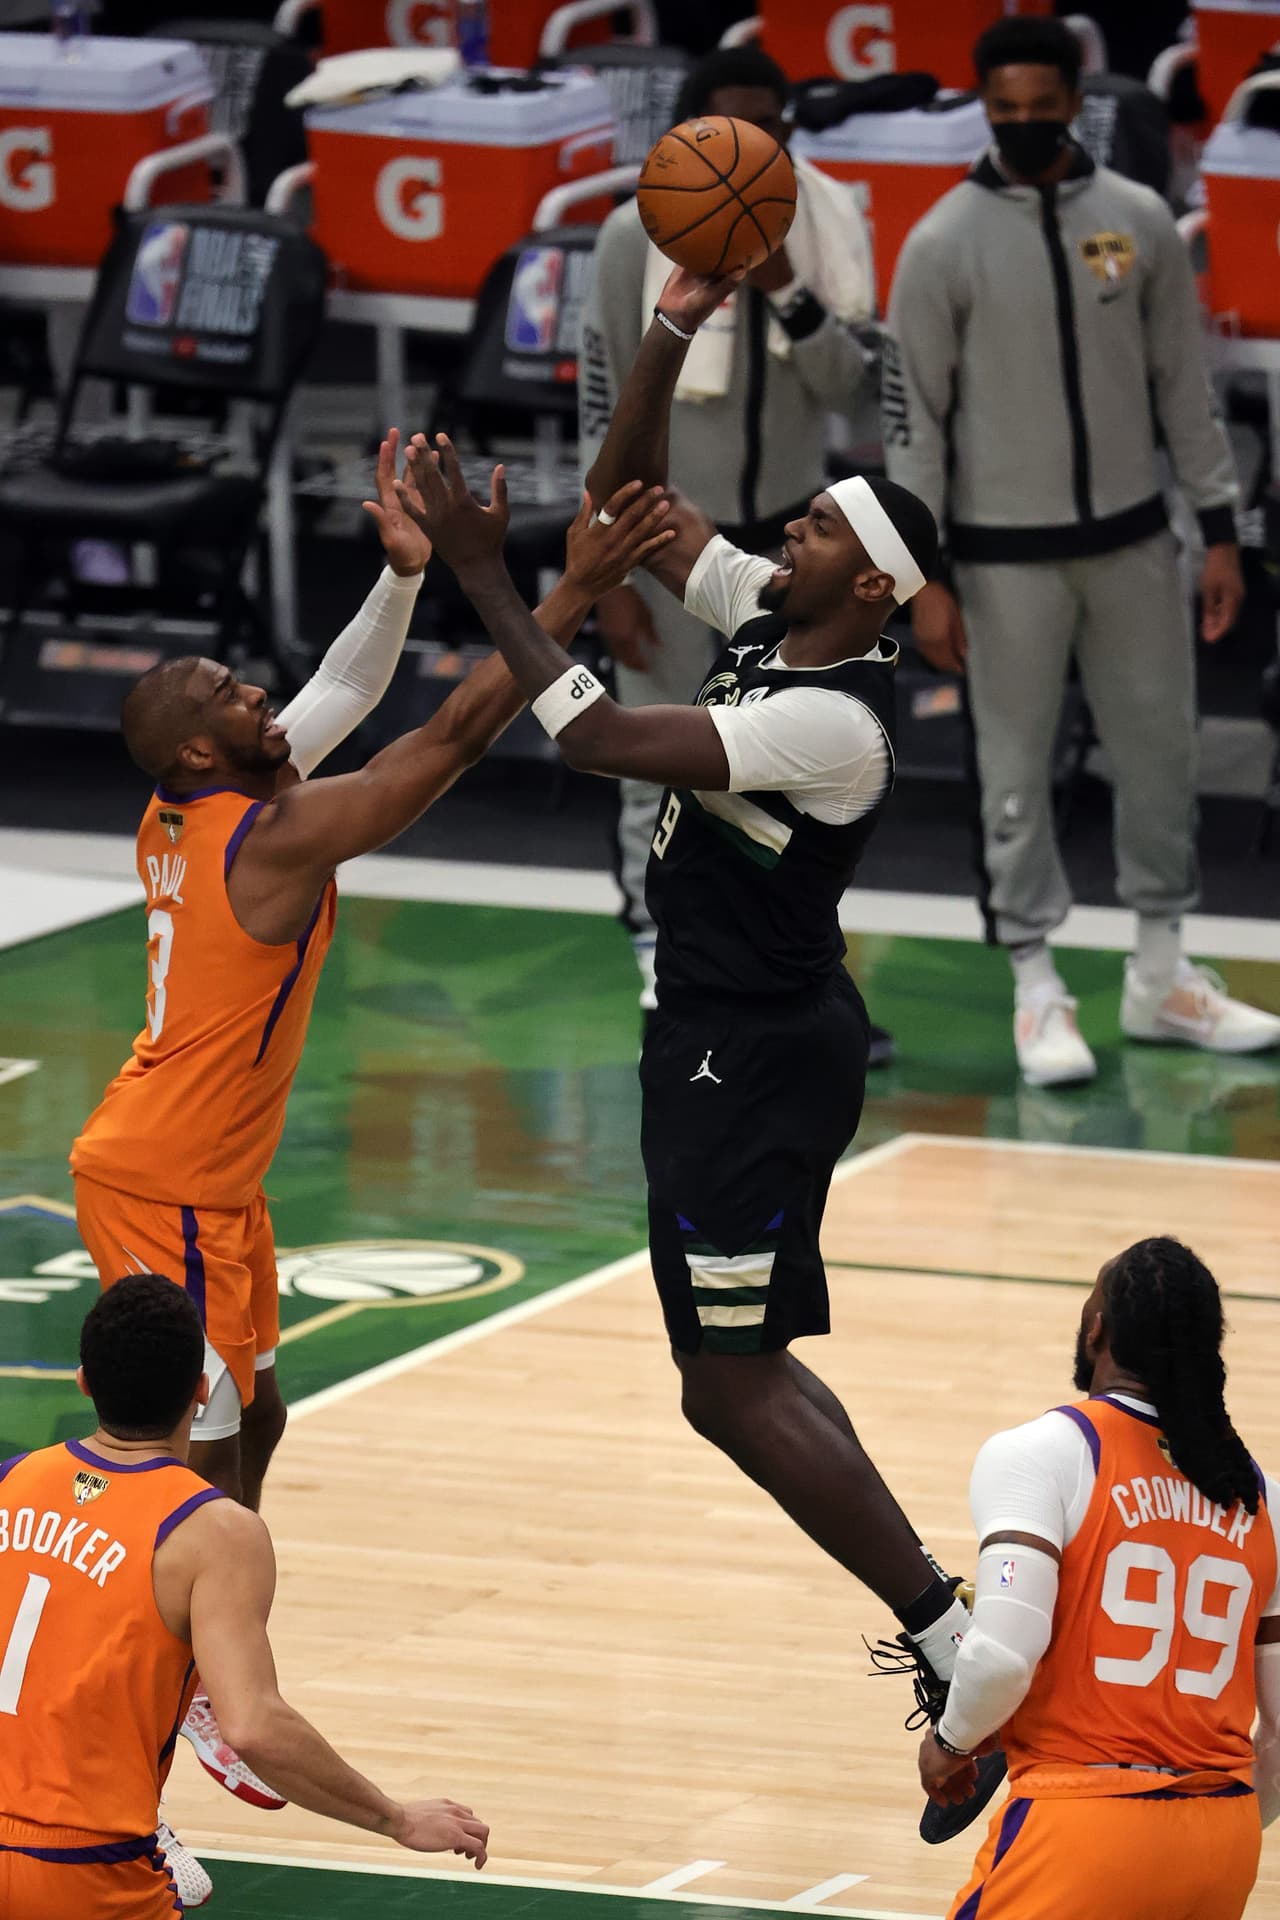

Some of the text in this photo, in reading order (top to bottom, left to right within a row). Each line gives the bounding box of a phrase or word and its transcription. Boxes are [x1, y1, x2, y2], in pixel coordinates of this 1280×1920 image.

[826, 4, 896, 82] G
[0, 127, 56, 212] G
[374, 155, 446, 242] G
[570, 673, 595, 700] BP
[652, 791, 682, 861] 9
[146, 853, 187, 905] PAUL
[1111, 1475, 1255, 1549] CROWDER
[0, 1571, 51, 1716] 1
[1094, 1540, 1253, 1700] 99
